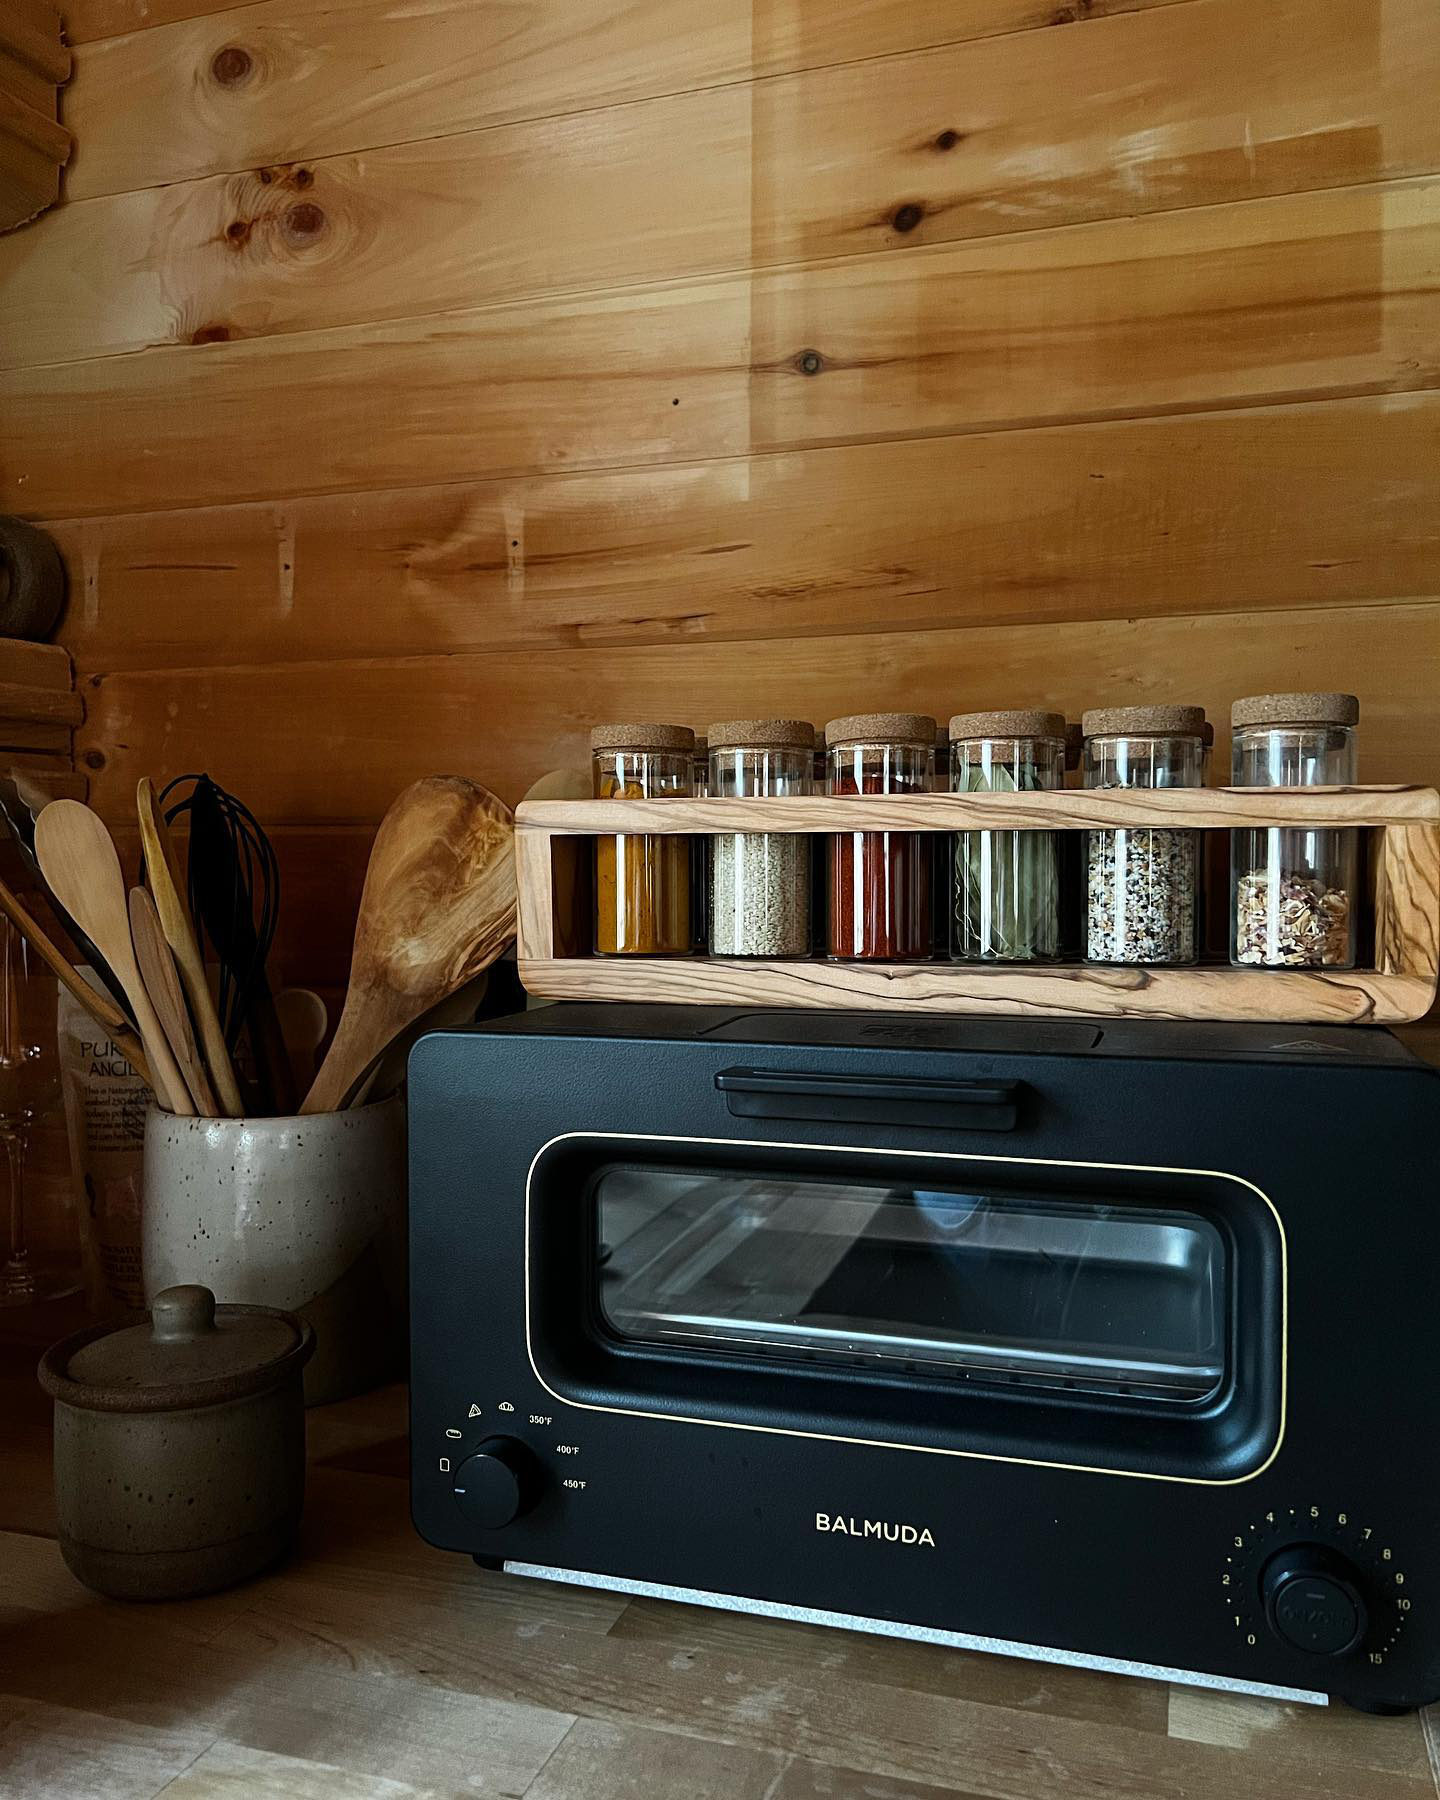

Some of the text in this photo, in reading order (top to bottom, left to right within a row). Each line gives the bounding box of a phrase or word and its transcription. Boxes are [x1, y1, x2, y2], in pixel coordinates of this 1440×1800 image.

[80, 1041, 125, 1057] PUR
[89, 1061, 140, 1077] ANCI
[529, 1414, 552, 1425] 350°F
[556, 1444, 580, 1455] 400°F
[563, 1479, 587, 1490] 450°F
[815, 1512, 936, 1547] BALMUDA
[1222, 1506, 1411, 1664] 0 1 2 3 4 5 6 7 8 9 10 15
